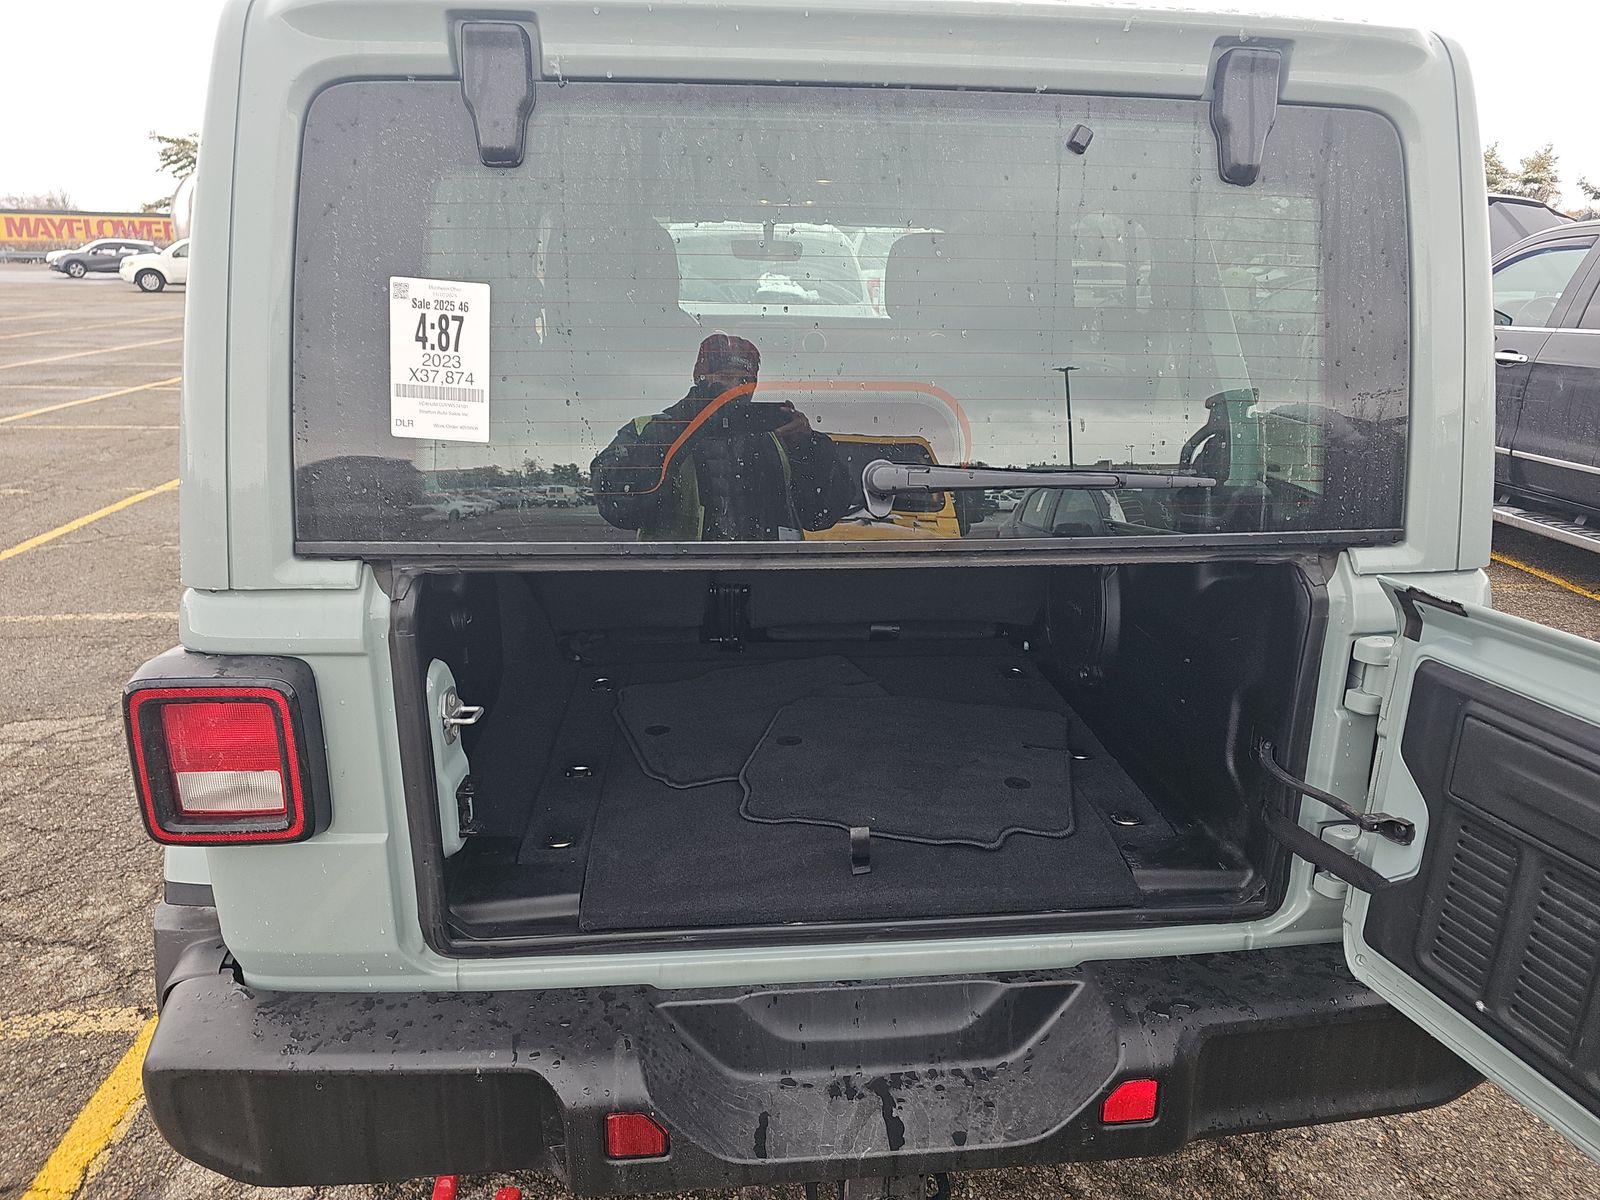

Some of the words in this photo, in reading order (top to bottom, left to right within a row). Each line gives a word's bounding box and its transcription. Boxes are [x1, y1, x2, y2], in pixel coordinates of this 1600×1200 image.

[411, 298, 431, 310] Sale
[434, 299, 455, 311] 2025
[458, 301, 469, 312] 46
[415, 312, 464, 352] 4:87
[422, 353, 461, 368] 2023
[409, 367, 475, 386] X37,874
[395, 418, 414, 428] DLR
